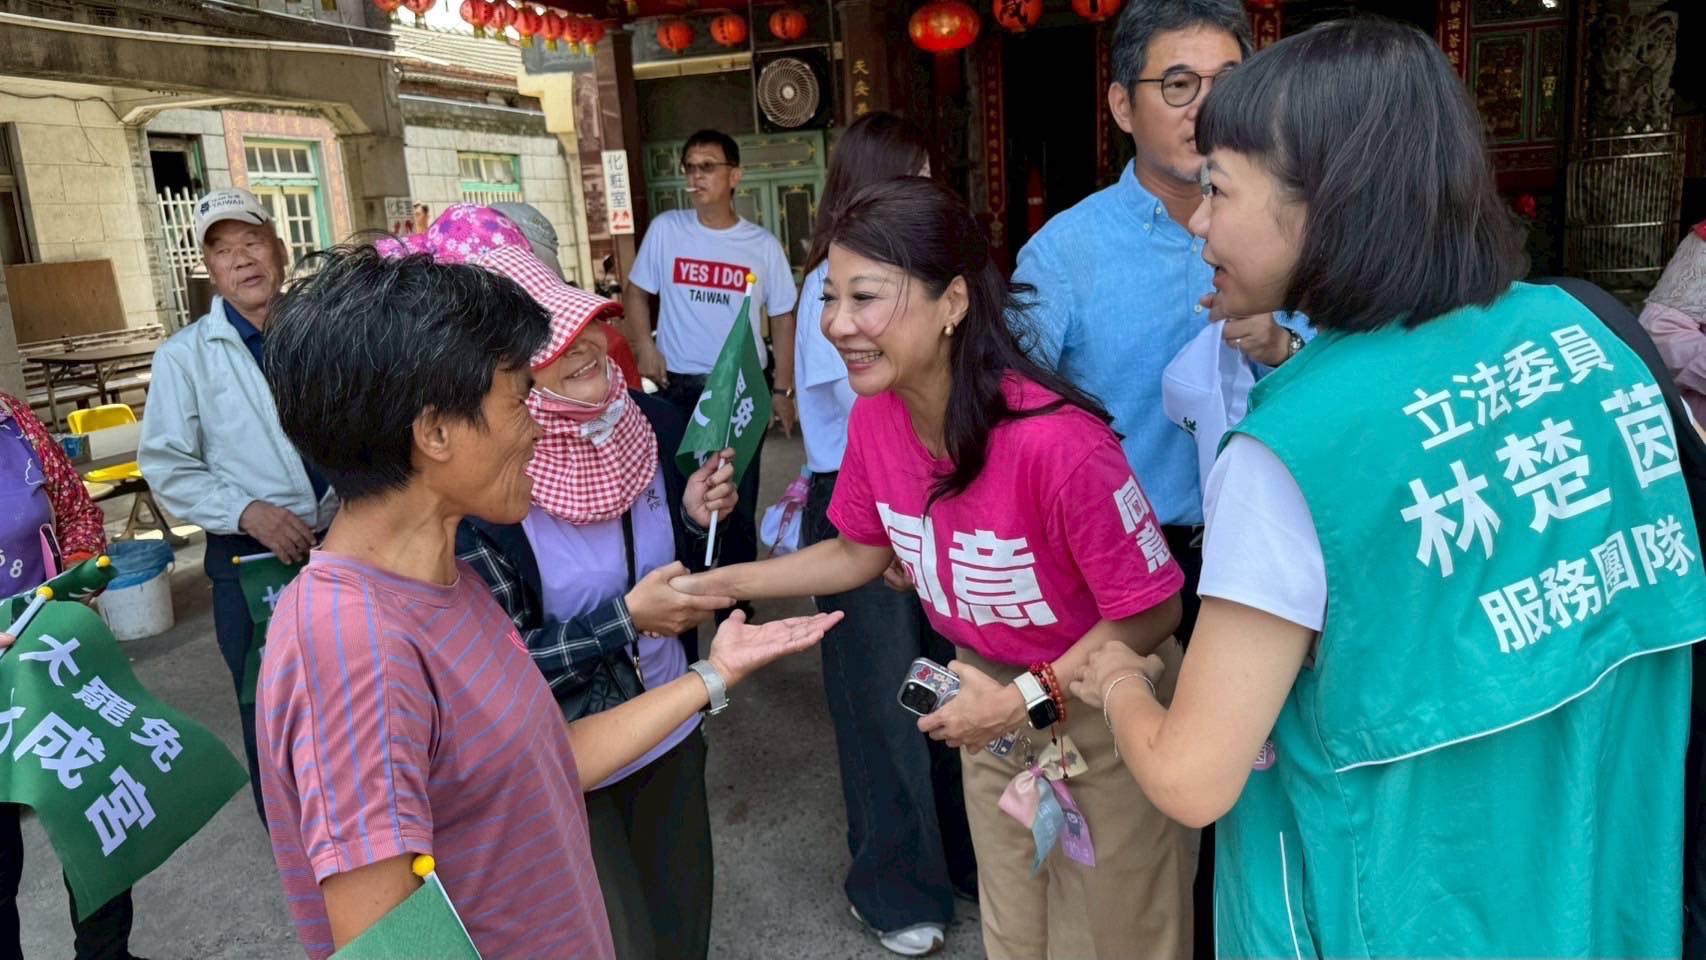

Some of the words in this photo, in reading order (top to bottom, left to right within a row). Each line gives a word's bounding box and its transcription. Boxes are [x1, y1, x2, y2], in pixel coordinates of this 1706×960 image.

[680, 262, 710, 283] YES
[713, 266, 719, 285] I
[722, 268, 744, 288] DO
[689, 289, 730, 305] TAIWAN
[1402, 324, 1614, 450] 立法委員
[1113, 474, 1170, 574] 同意
[1400, 382, 1682, 578] 林楚茵
[876, 501, 1059, 628] 同意
[1478, 514, 1695, 653] 服務團隊
[19, 634, 183, 773] 大罷免
